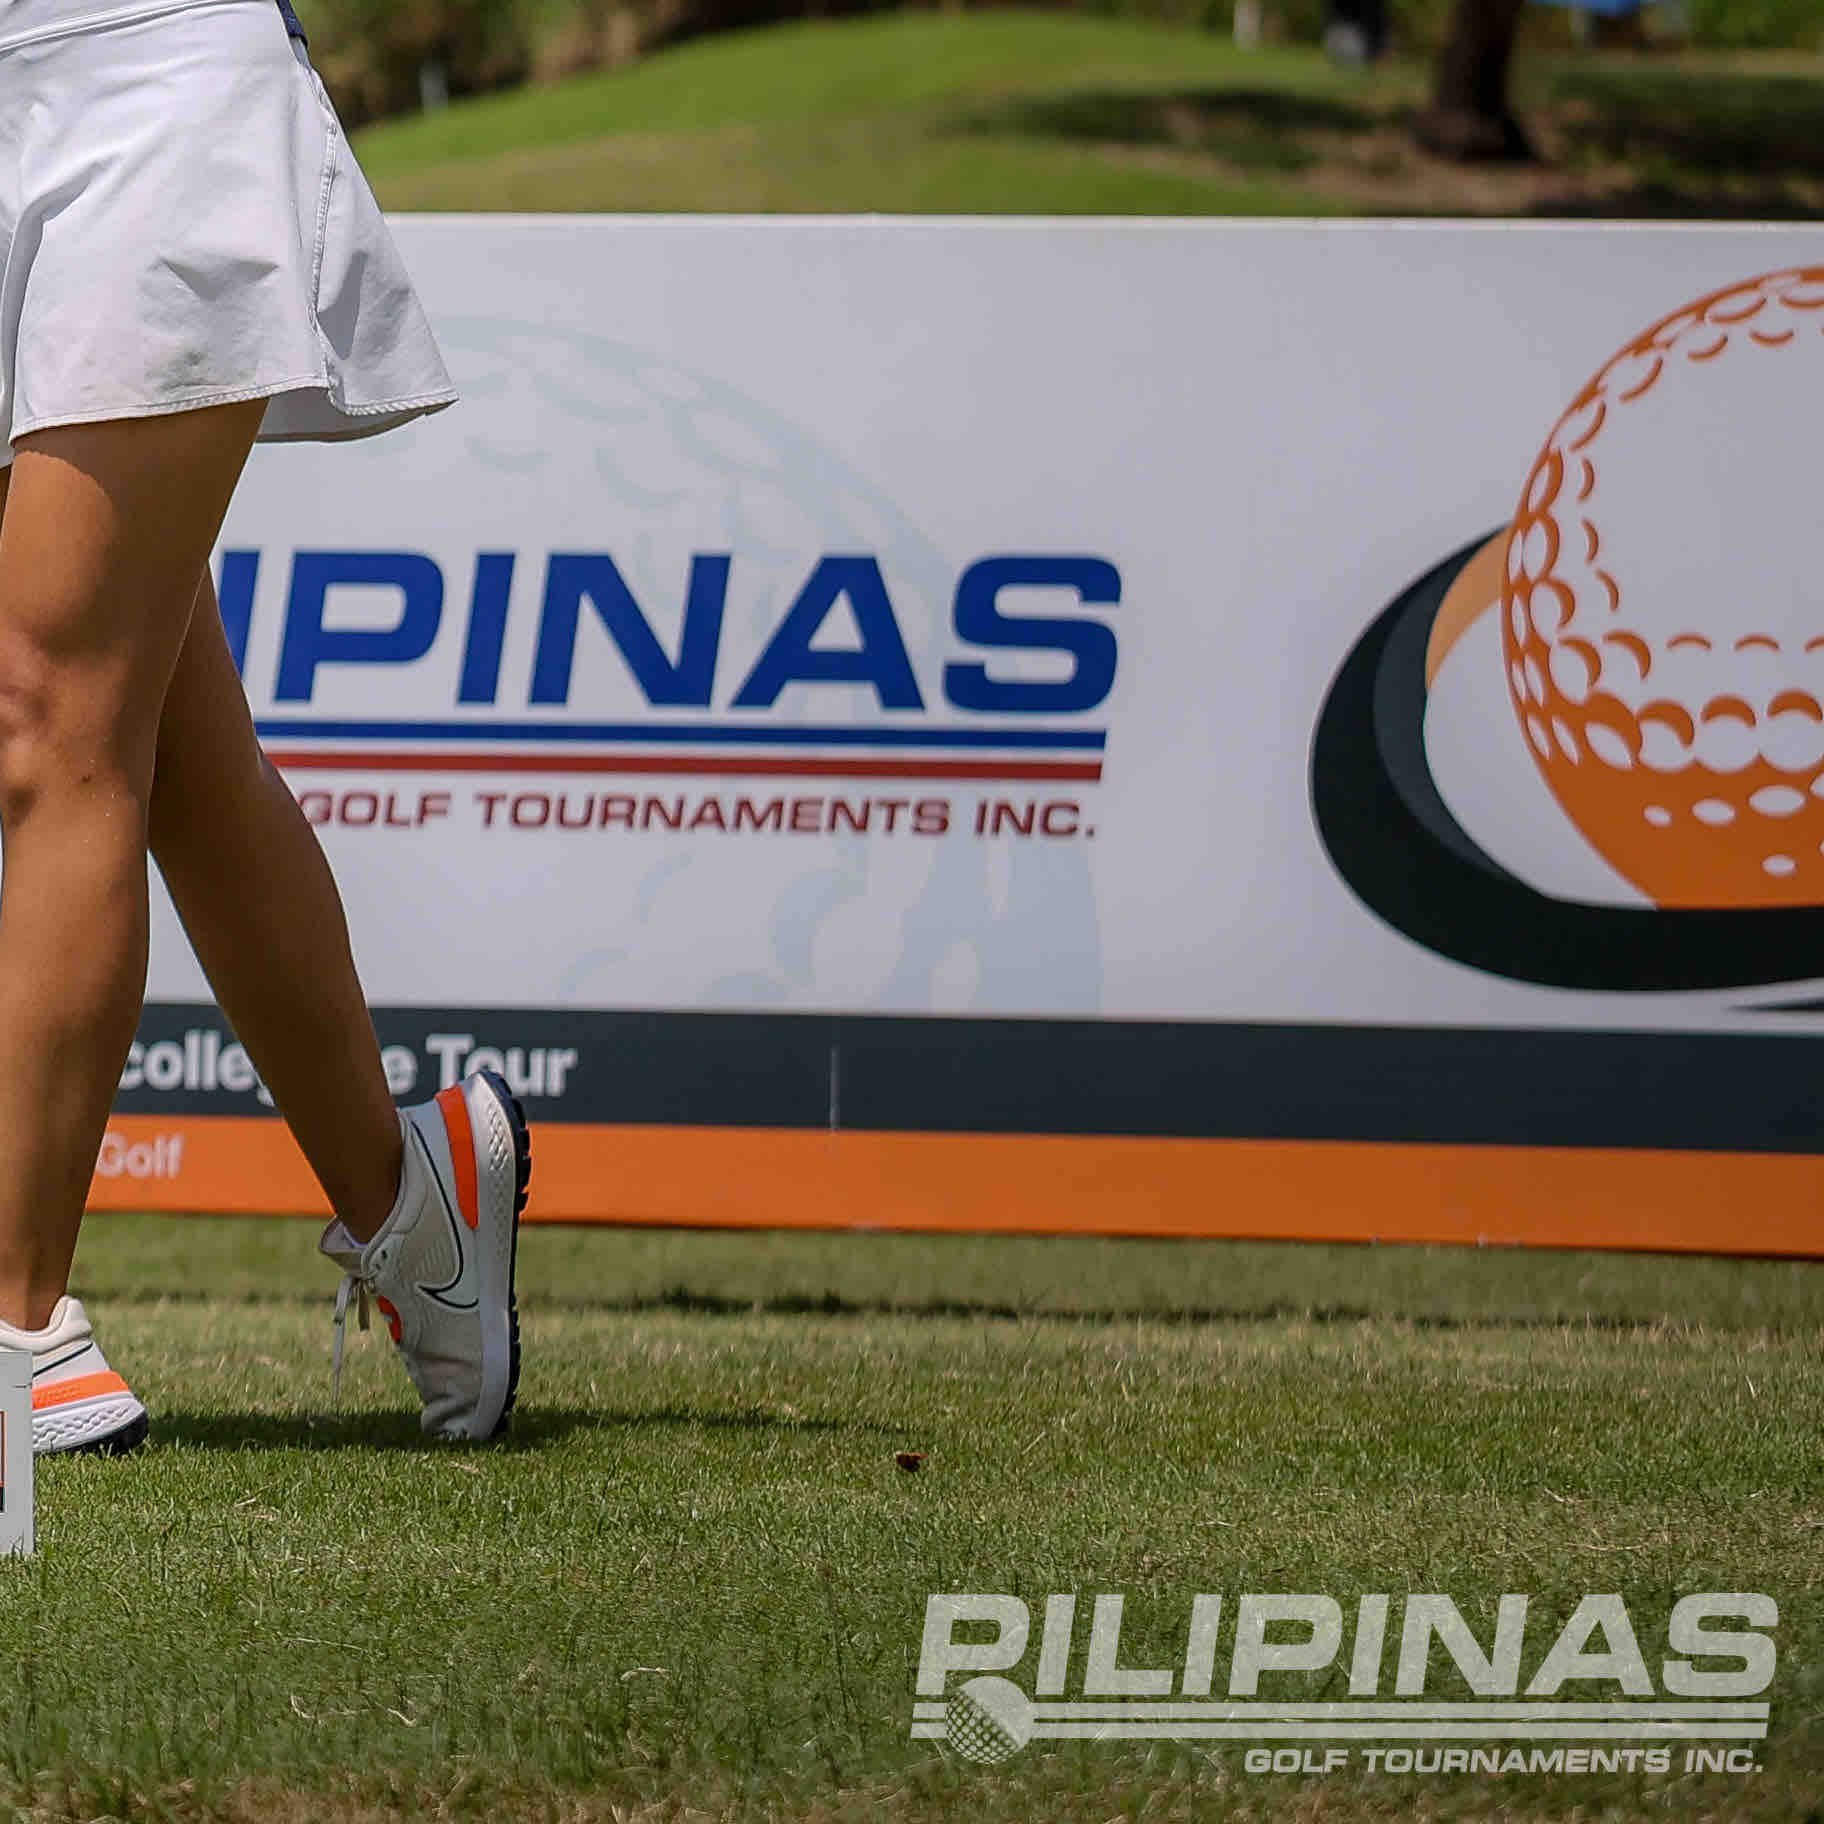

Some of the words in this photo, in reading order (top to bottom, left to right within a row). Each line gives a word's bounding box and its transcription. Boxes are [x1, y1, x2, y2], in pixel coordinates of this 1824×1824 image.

[297, 791, 452, 827] GOLF
[474, 792, 952, 834] TOURNAMENTS
[974, 798, 1097, 838] INC.
